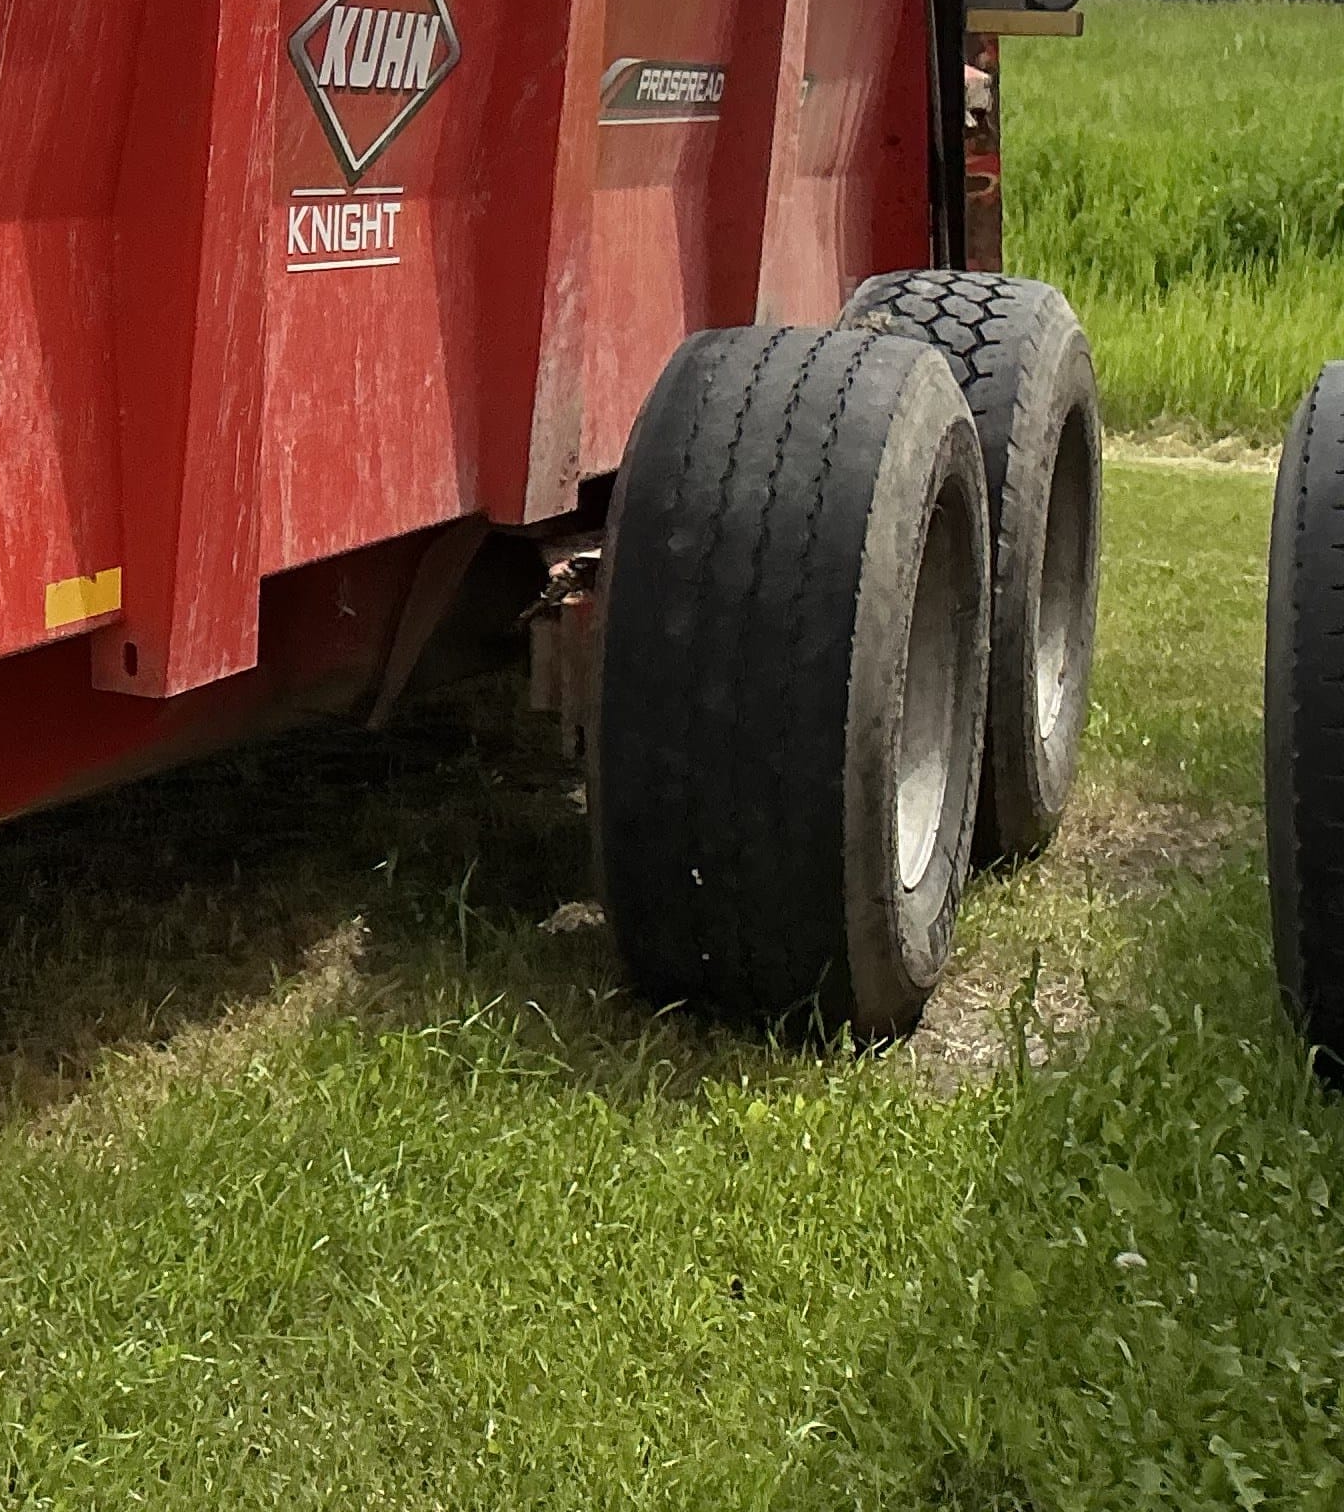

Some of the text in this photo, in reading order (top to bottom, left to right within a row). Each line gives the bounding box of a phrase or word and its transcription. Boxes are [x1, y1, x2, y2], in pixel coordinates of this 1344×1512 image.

[318, 5, 440, 89] KUHN
[636, 68, 725, 102] PROSPREAD
[287, 202, 401, 255] KNIGHT
